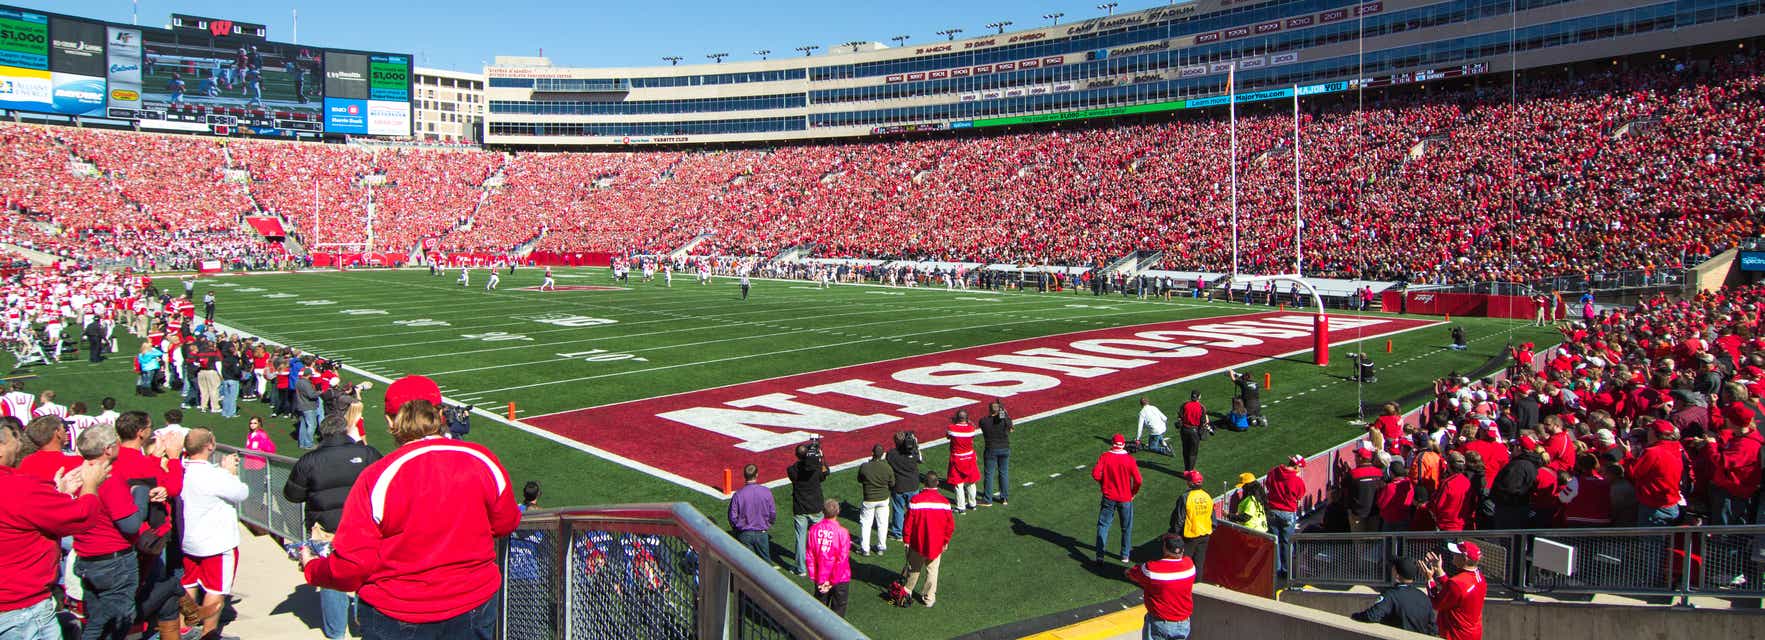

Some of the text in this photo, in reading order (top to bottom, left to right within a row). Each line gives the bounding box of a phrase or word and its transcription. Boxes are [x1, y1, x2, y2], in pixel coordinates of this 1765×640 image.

[1357, 4, 1379, 14] 2012
[1066, 6, 1195, 35] CAMP RANDALL STADIUM
[1324, 11, 1342, 21] 2011
[1289, 17, 1311, 27] 2010
[1, 29, 45, 44] $1,000
[925, 44, 952, 54] AMECHE
[1110, 41, 1170, 57] CHAMPIONS
[373, 71, 406, 80] $1,000
[1135, 73, 1163, 83] BOWL
[1192, 97, 1210, 107] Learn
[1236, 90, 1285, 101] MajorYou.com
[656, 313, 1393, 455] WISCONSIN
[817, 529, 834, 539] CSC
